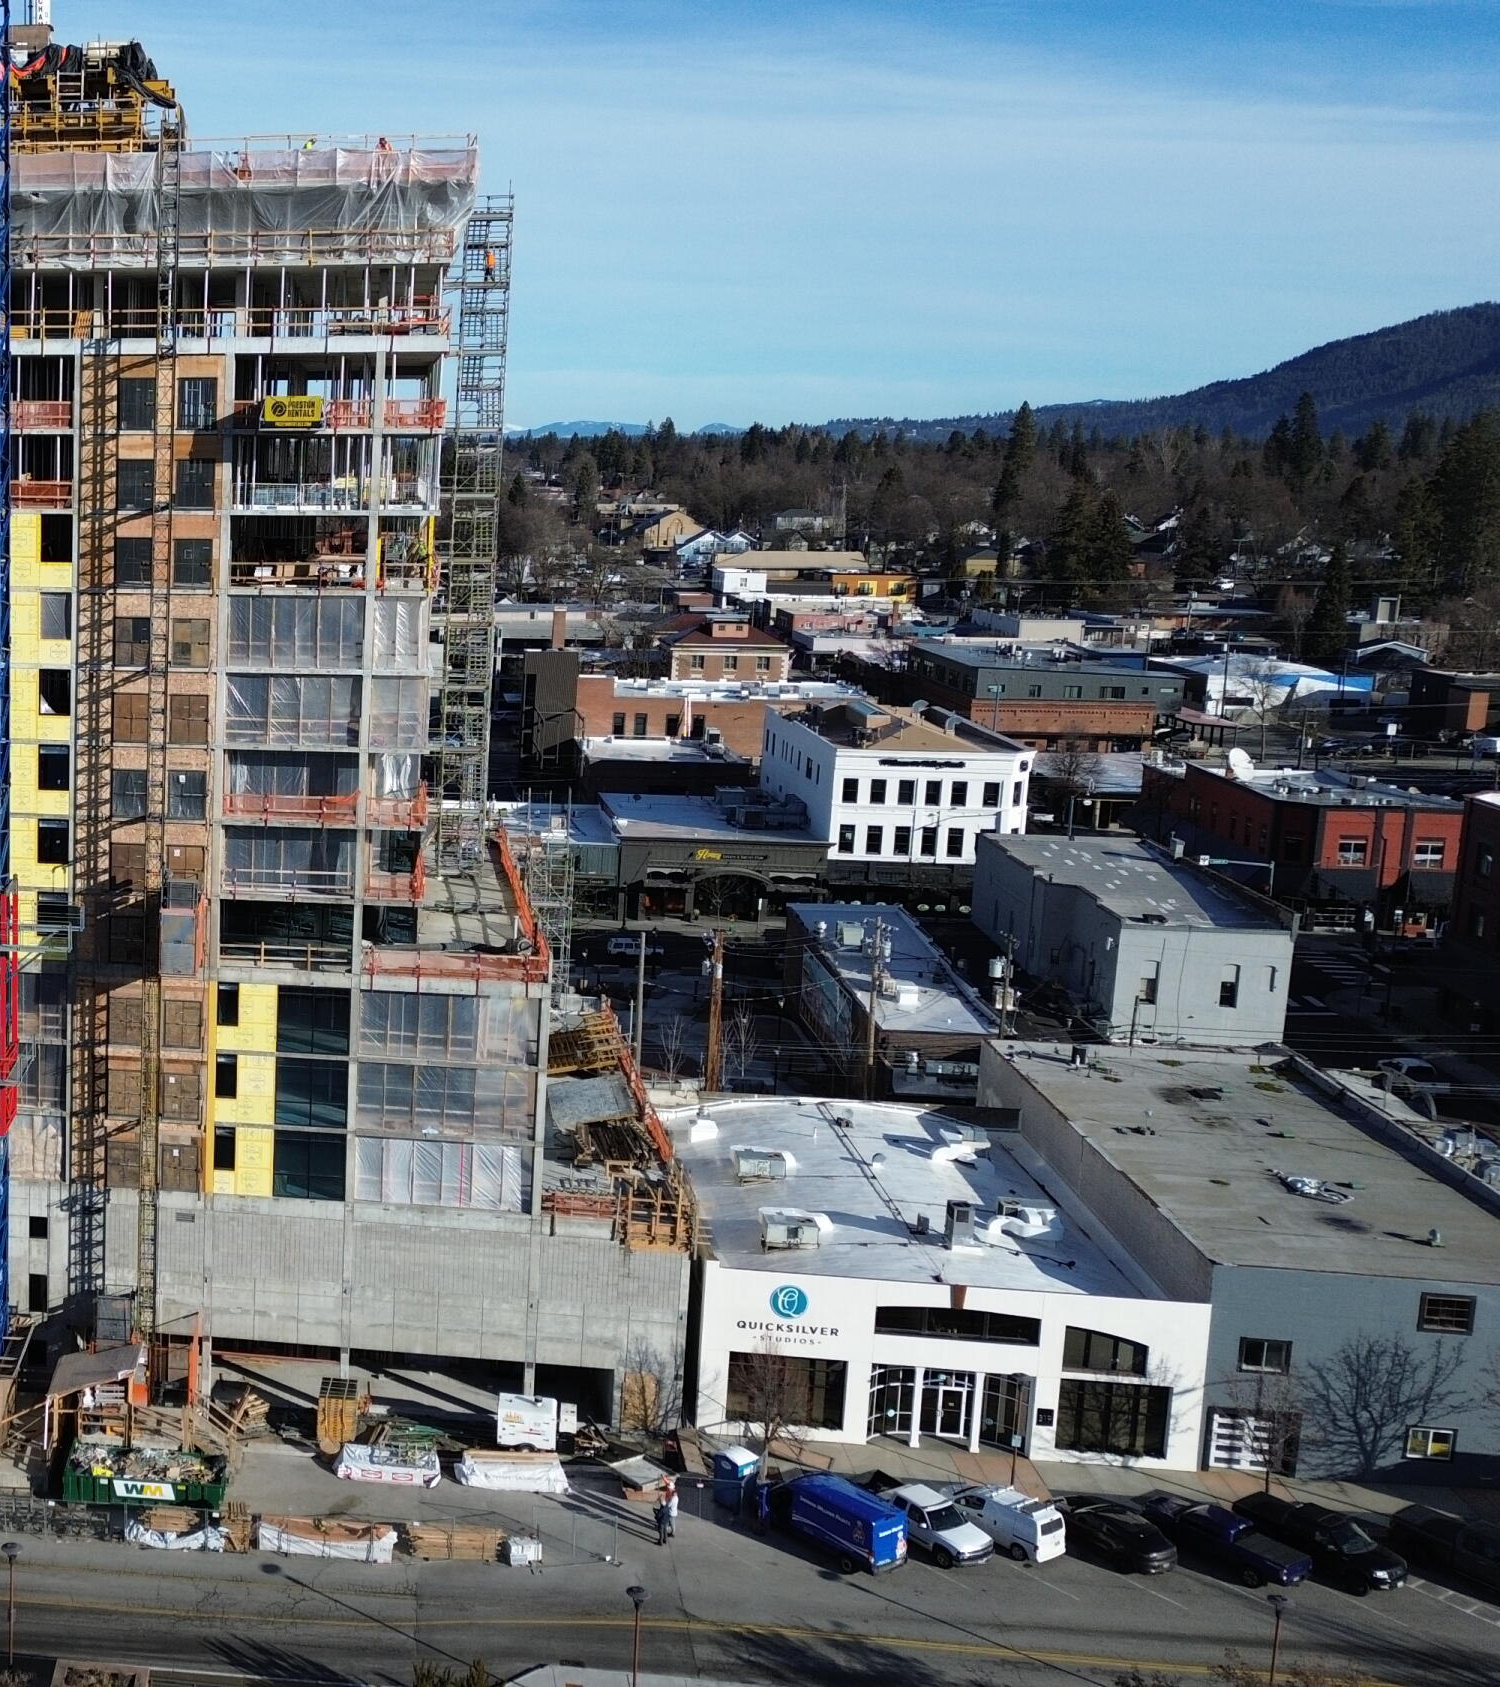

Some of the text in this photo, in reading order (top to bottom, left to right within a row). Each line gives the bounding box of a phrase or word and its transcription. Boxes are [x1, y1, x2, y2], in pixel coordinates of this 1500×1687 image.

[288, 400, 316, 409] PRESTON
[288, 409, 315, 417] RENTALS
[736, 1320, 840, 1337] QUICKSILVER
[760, 1334, 816, 1345] STUDIOS
[123, 1483, 164, 1497] WM
